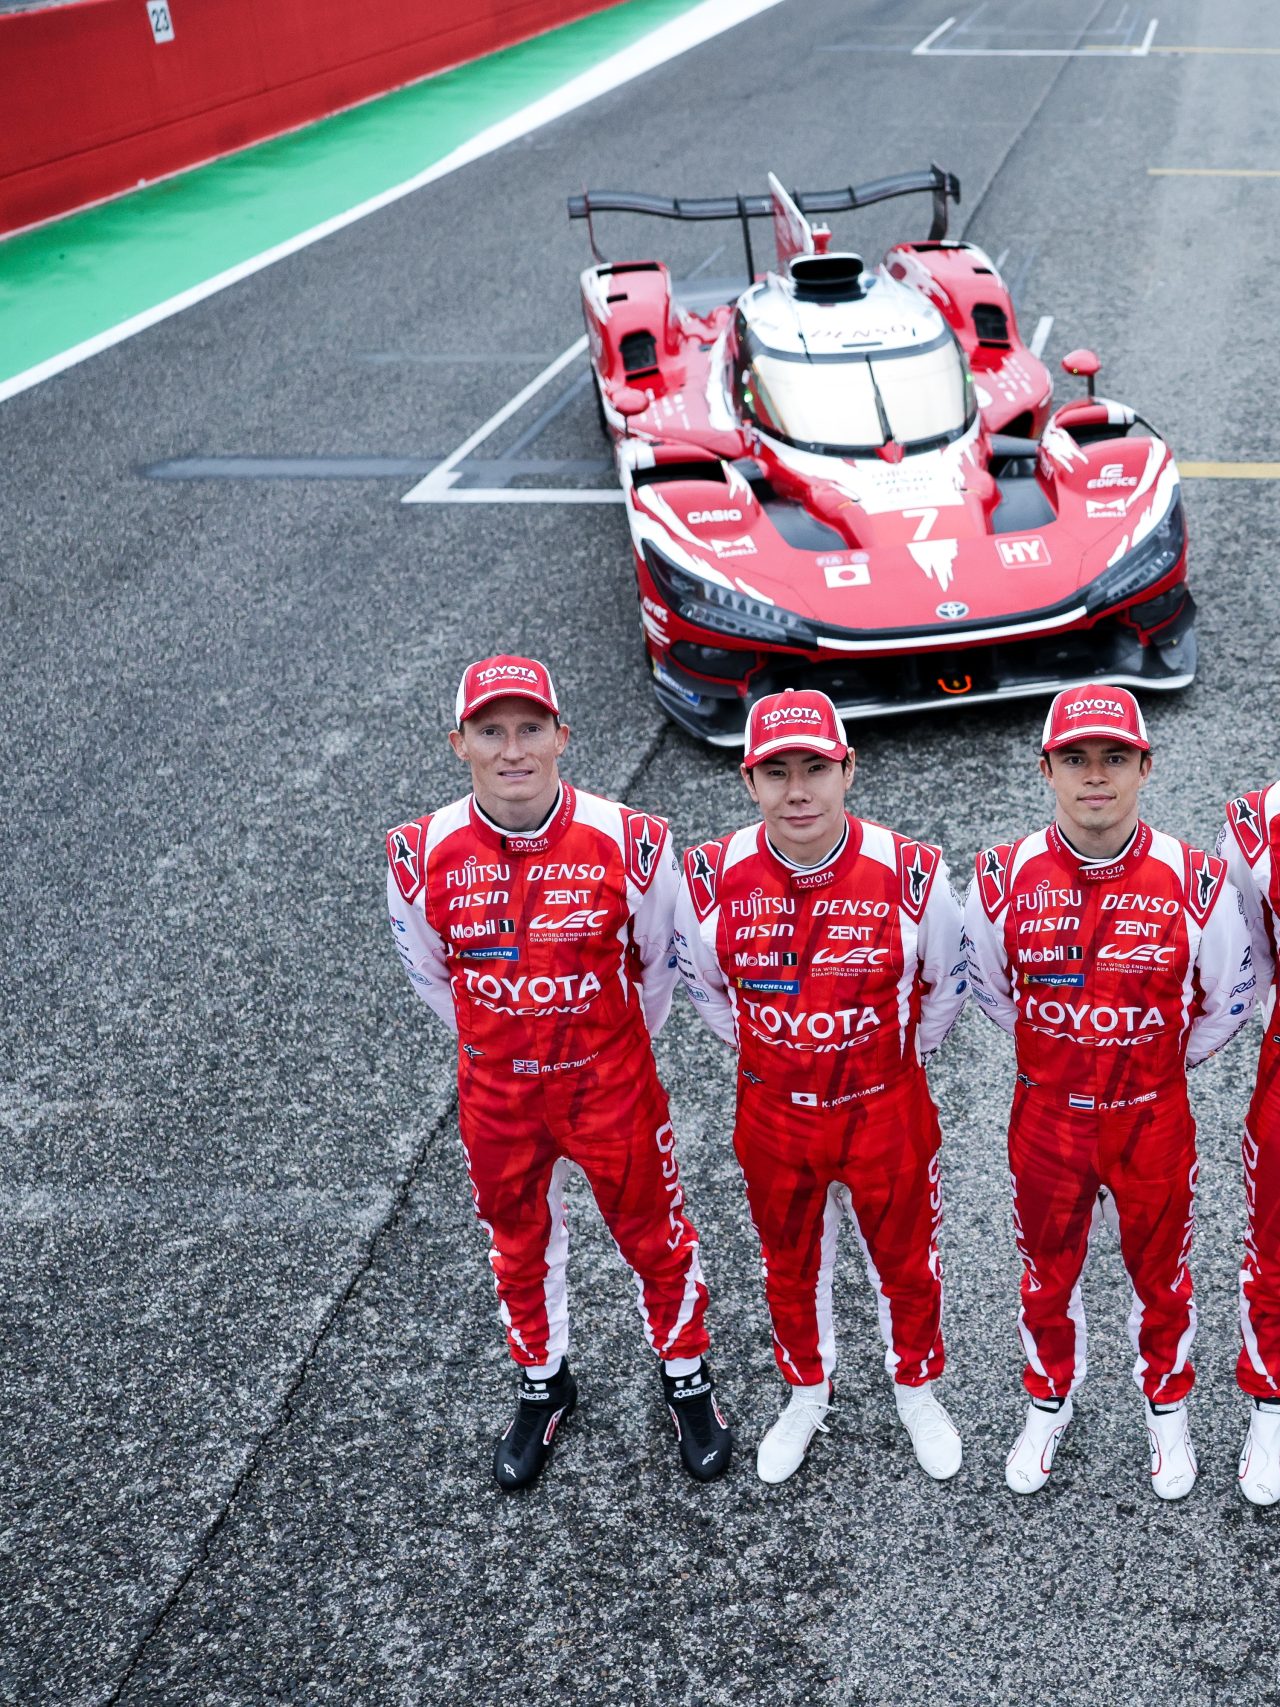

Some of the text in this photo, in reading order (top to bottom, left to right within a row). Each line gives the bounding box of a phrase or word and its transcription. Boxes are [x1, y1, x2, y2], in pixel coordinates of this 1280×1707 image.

[152, 7, 170, 32] 23
[1087, 477, 1138, 489] EDIFICE
[687, 509, 742, 524] CASIO
[901, 508, 939, 541] 7
[1000, 540, 1041, 564] HY
[476, 665, 538, 681] TOYOTA
[1064, 698, 1124, 715] TOYOTA
[1066, 709, 1124, 720] RACING
[761, 707, 822, 725] TOYOTA
[763, 719, 822, 730] RACING
[509, 838, 550, 849] TOYOTA
[446, 856, 510, 889] FUJITSU
[527, 863, 605, 881] DENSO
[796, 871, 835, 885] TOYOTA
[1085, 864, 1125, 876] TOYOTA
[449, 891, 509, 910] AISIN
[543, 890, 591, 905] ZENT
[731, 888, 795, 920] FUJITSU
[1016, 879, 1082, 914] FUJITSU
[1100, 893, 1179, 916] DENSO
[811, 900, 890, 918] DENSO
[529, 909, 608, 930] WEC
[1019, 917, 1080, 934] AISIN
[450, 919, 495, 939] Mobil
[735, 924, 795, 940] AISIN
[827, 926, 873, 941] ZENT
[1114, 920, 1161, 938] ZENT
[735, 951, 778, 967] Mobil
[811, 947, 889, 964] WEC
[1019, 946, 1064, 963] Mobil
[1097, 944, 1176, 964] WEC
[1131, 964, 1168, 972] ENDURANCE
[463, 967, 602, 1004] TOYOTA
[752, 983, 794, 991] MICHELIN
[470, 996, 594, 1017] RACING
[1025, 995, 1165, 1032] TOYOTA
[742, 997, 881, 1039] TOYOTA
[750, 1027, 874, 1053] RACING
[1028, 1025, 1158, 1047] RACING
[1110, 1101, 1126, 1109] DE
[1128, 1091, 1157, 1105] VRIES
